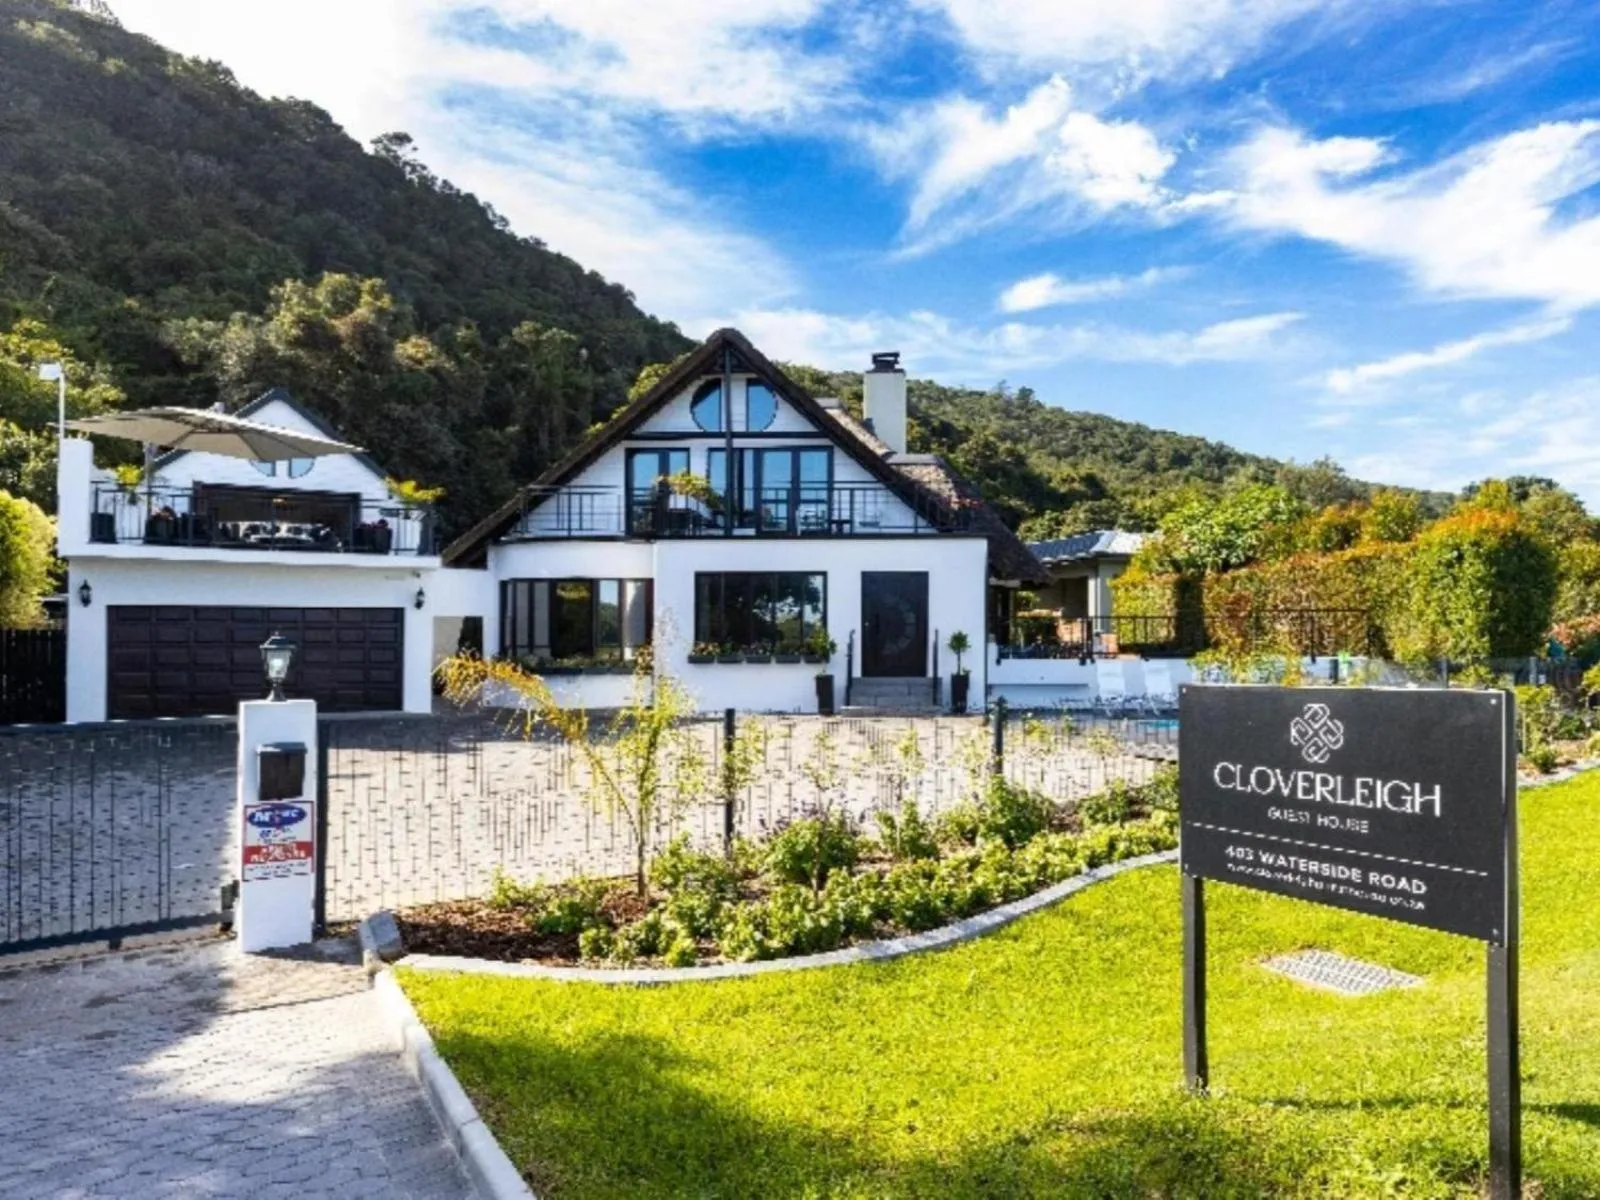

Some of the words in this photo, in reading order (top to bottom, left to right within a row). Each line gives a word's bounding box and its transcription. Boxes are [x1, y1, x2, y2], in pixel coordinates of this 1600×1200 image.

[1213, 762, 1442, 818] CLOVERLEIGH
[1259, 850, 1363, 883] WATERSIDE
[1368, 872, 1426, 894] ROAD
